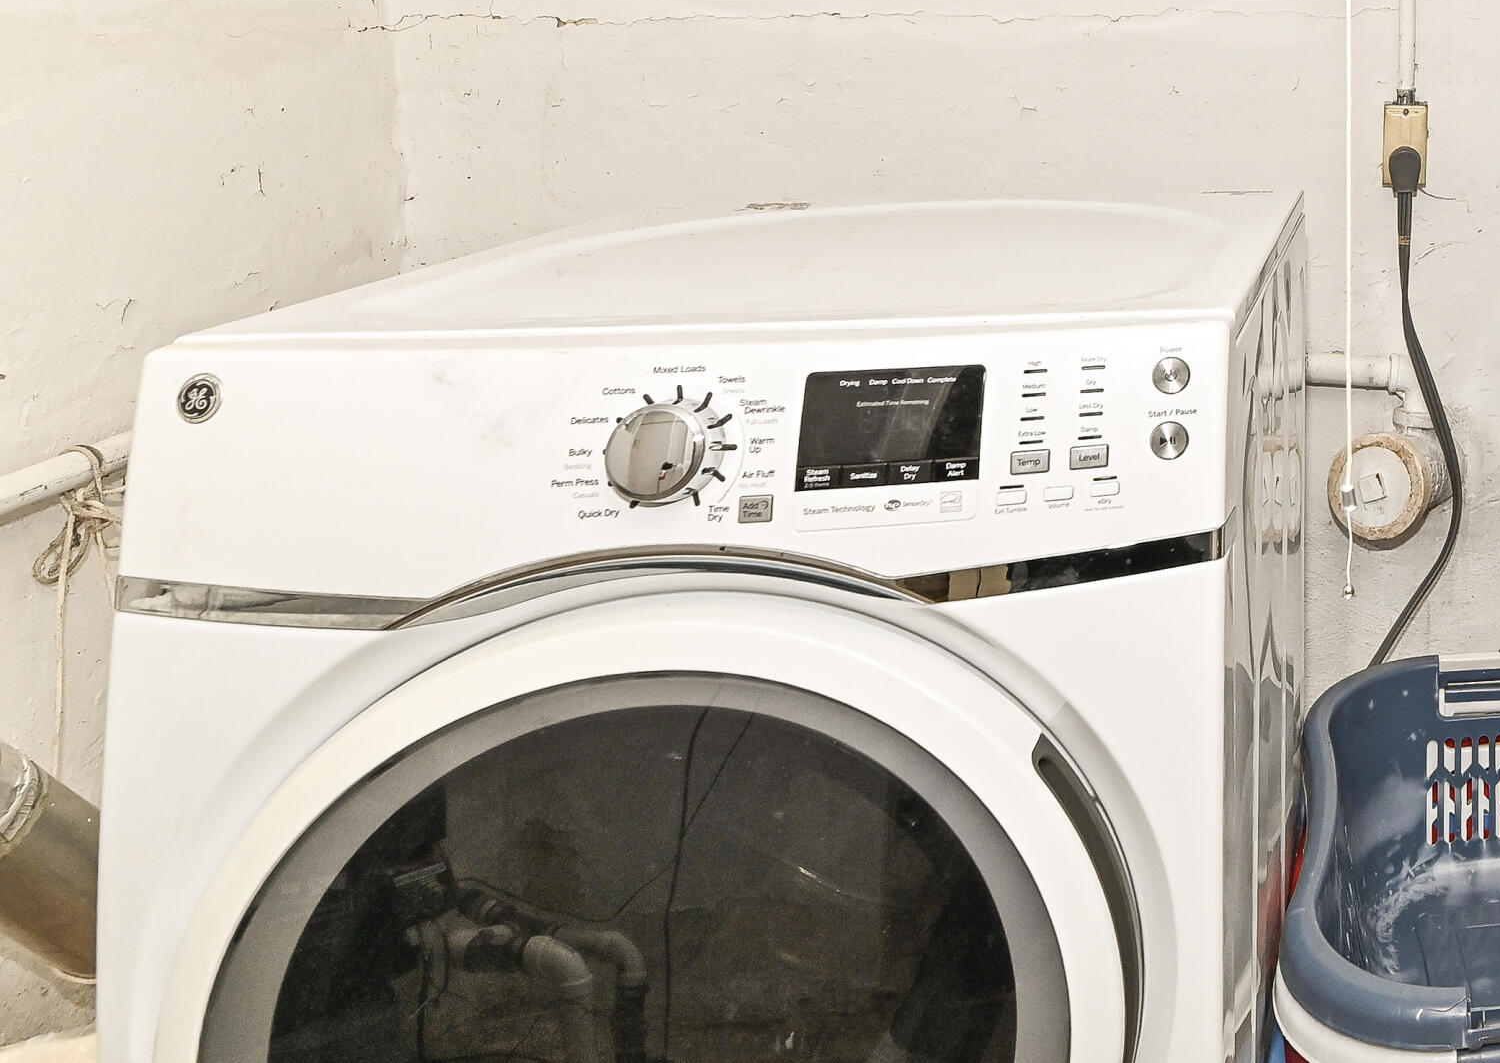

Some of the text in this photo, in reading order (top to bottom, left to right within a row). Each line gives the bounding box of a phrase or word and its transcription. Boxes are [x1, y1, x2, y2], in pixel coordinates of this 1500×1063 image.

[653, 365, 707, 374] Mixed Loads
[718, 376, 746, 384] Towels
[839, 379, 860, 387] Drying
[869, 378, 888, 386] Damp
[927, 376, 957, 384] Complete
[602, 387, 636, 395] Cottons
[739, 398, 767, 406] Steam
[744, 405, 785, 414] Dewrinkle
[1148, 409, 1167, 418] Start
[1175, 408, 1198, 416] Pause
[570, 415, 609, 425] Delicates
[750, 437, 775, 445] Warm
[568, 448, 593, 457] Bulky
[749, 446, 761, 454] Up
[1017, 457, 1041, 467] Temp
[1078, 453, 1100, 462] Level
[900, 465, 920, 473] Delay
[945, 461, 967, 469] Damp
[743, 469, 775, 479] Air Fluff
[806, 468, 829, 476] Steam
[850, 472, 878, 481] Sanitize
[903, 472, 917, 481] Dry
[947, 469, 964, 477] Alert
[551, 478, 600, 488] Perm Press
[804, 475, 831, 483] Refresh
[709, 505, 730, 513] Time
[742, 501, 759, 510] Add
[803, 504, 876, 515] Steam Technology
[578, 509, 620, 520] Quick Dry
[708, 513, 724, 523] Dry
[743, 510, 763, 519] Time
